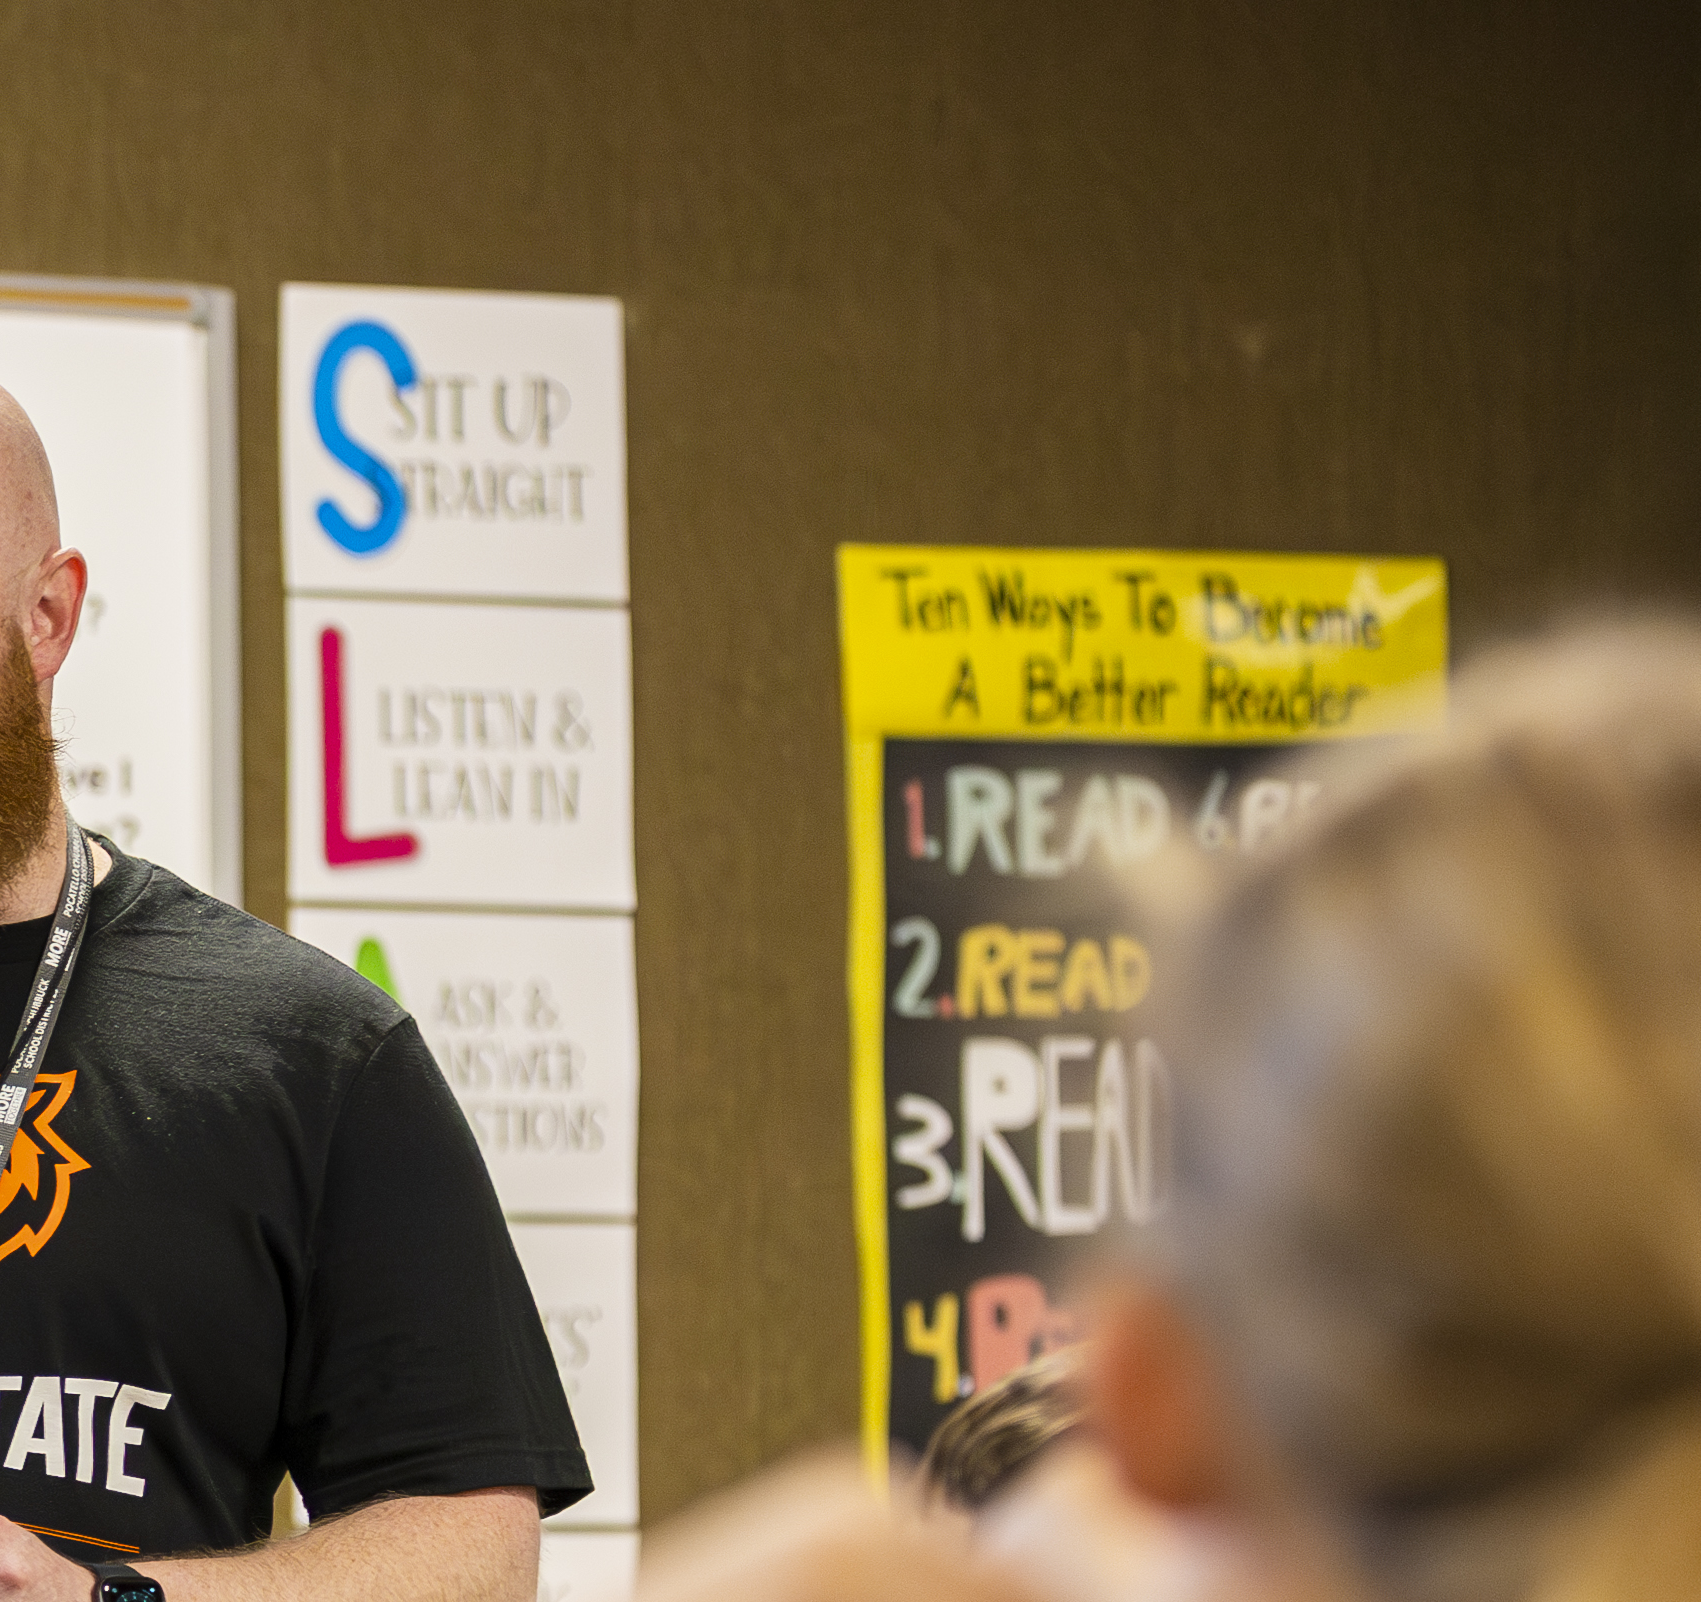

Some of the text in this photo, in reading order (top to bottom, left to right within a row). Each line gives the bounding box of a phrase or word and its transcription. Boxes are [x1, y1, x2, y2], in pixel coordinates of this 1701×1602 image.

[310, 317, 419, 558] S
[493, 374, 574, 447] UP
[881, 565, 971, 636] Ten
[976, 564, 1100, 662] Ways
[1113, 570, 1177, 637] To
[377, 685, 596, 753] LISTEN &
[943, 653, 1367, 731] A Better Reader
[317, 622, 424, 870] L
[392, 757, 581, 825] LEAN IN
[945, 766, 1174, 877] READ
[44, 926, 69, 968] MORE
[891, 914, 1153, 1019] 2. READ
[23, 1035, 43, 1070] SCHOOL
